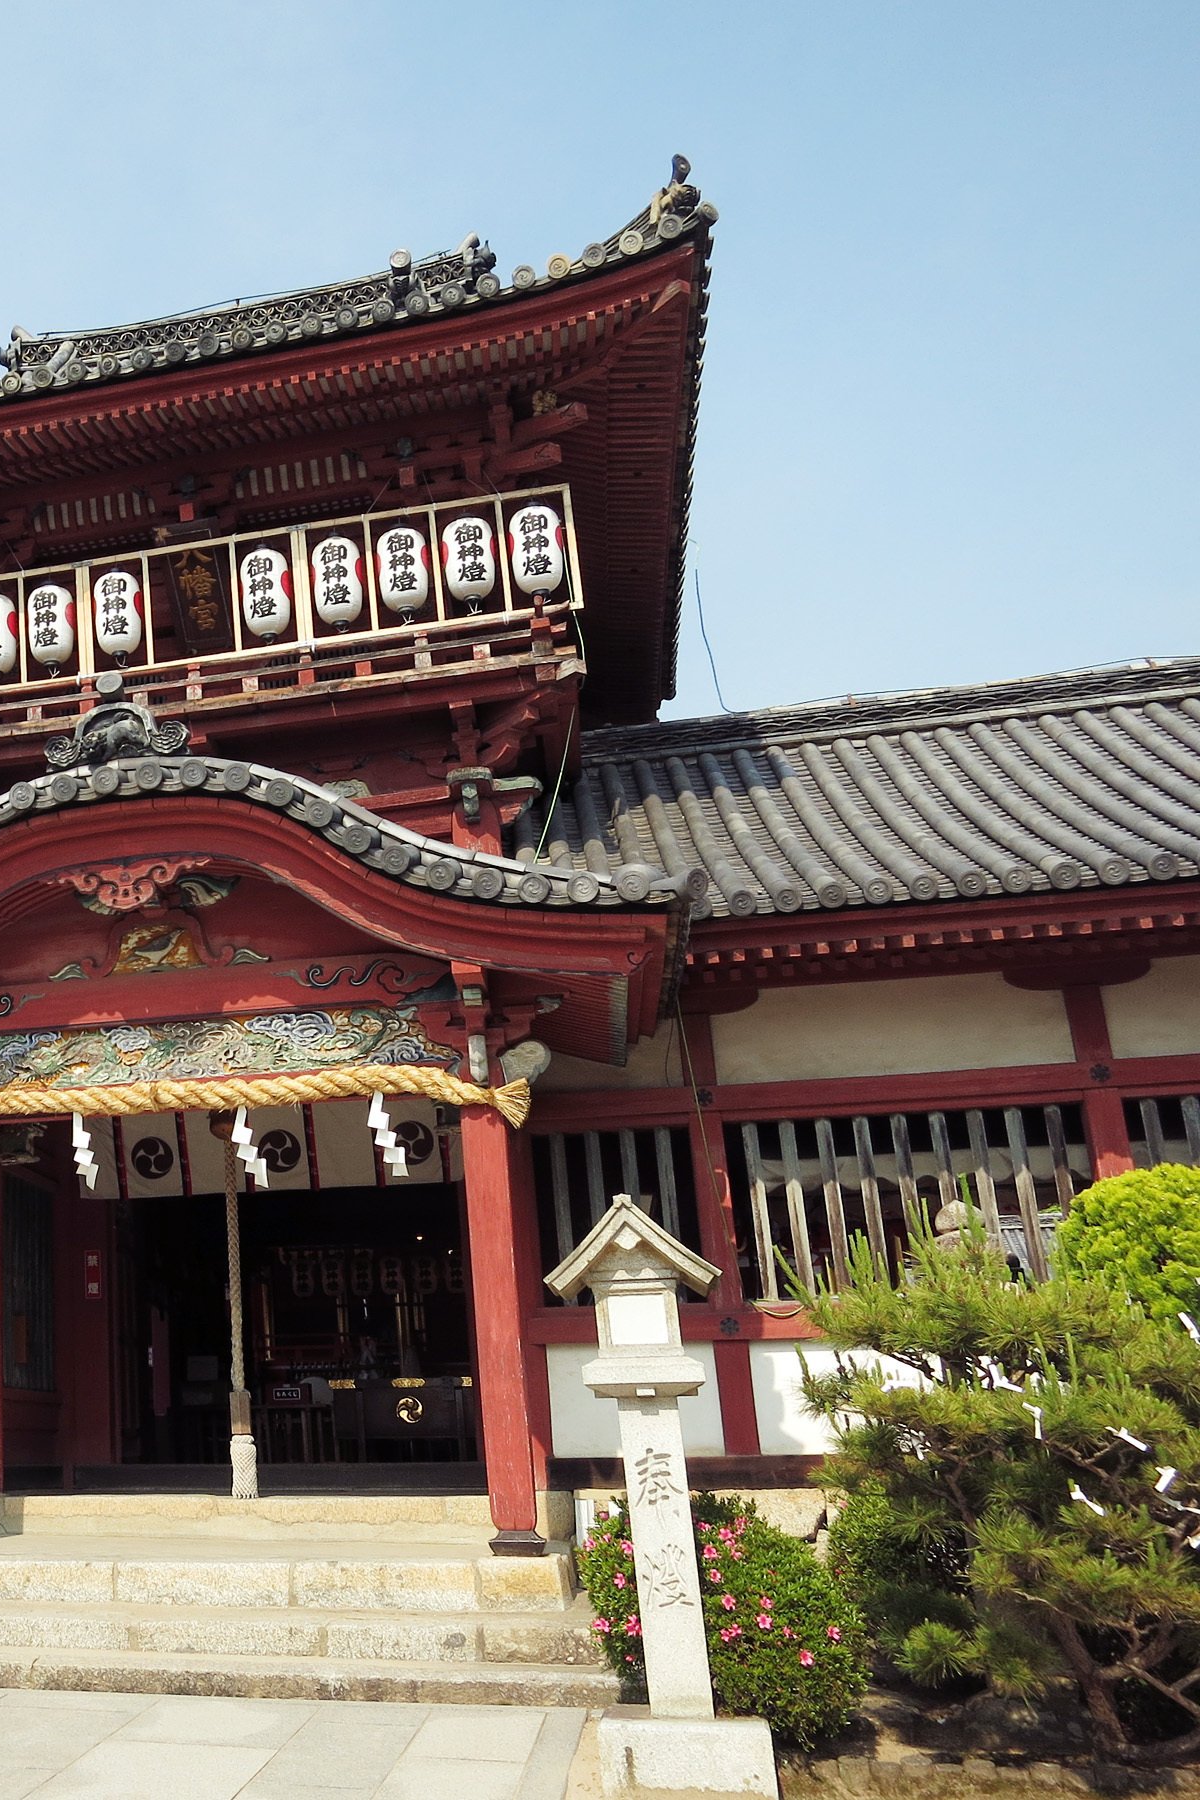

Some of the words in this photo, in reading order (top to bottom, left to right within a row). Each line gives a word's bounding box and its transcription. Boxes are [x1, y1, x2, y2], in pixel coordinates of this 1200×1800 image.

[321, 542, 351, 606] 御神燈
[387, 532, 417, 592] 御神燈
[454, 523, 487, 581] 御神燈
[519, 512, 552, 576] 御神燈
[101, 575, 129, 636] 御神燈
[247, 555, 277, 619] 御神燈
[33, 590, 60, 648] 御神燈
[87, 1255, 99, 1294] 禁煙
